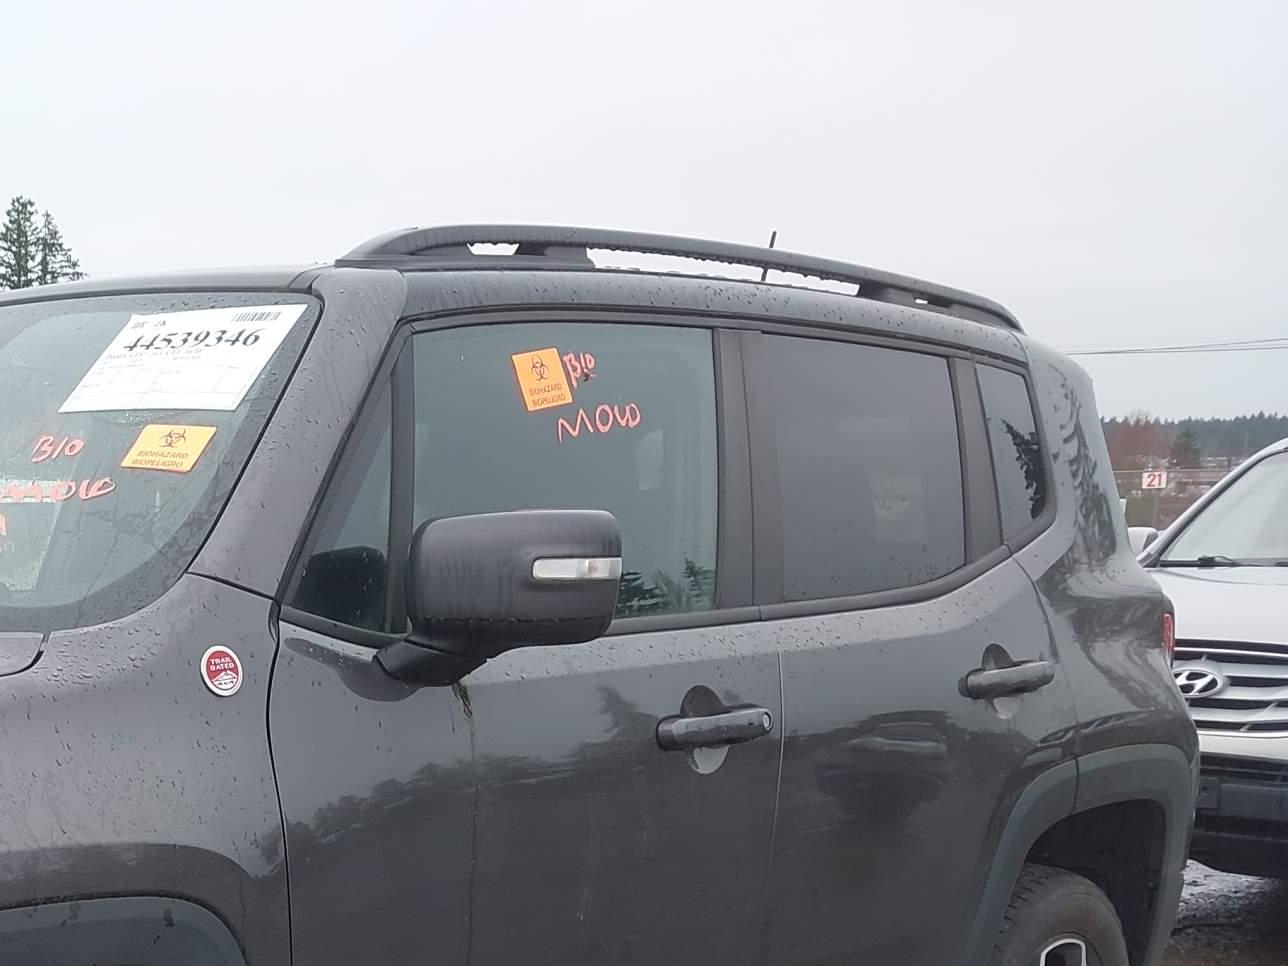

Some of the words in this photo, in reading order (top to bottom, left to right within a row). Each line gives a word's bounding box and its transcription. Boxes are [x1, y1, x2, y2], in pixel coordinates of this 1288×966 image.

[123, 328, 267, 351] 44539346
[529, 383, 563, 397] BIOHAZARD
[532, 394, 566, 407] BIOPELIGRO
[136, 450, 189, 459] BIOHAZARD
[131, 458, 183, 467] BIOPELIGRO
[1147, 473, 1163, 487] 21
[210, 657, 233, 665] TRAIL
